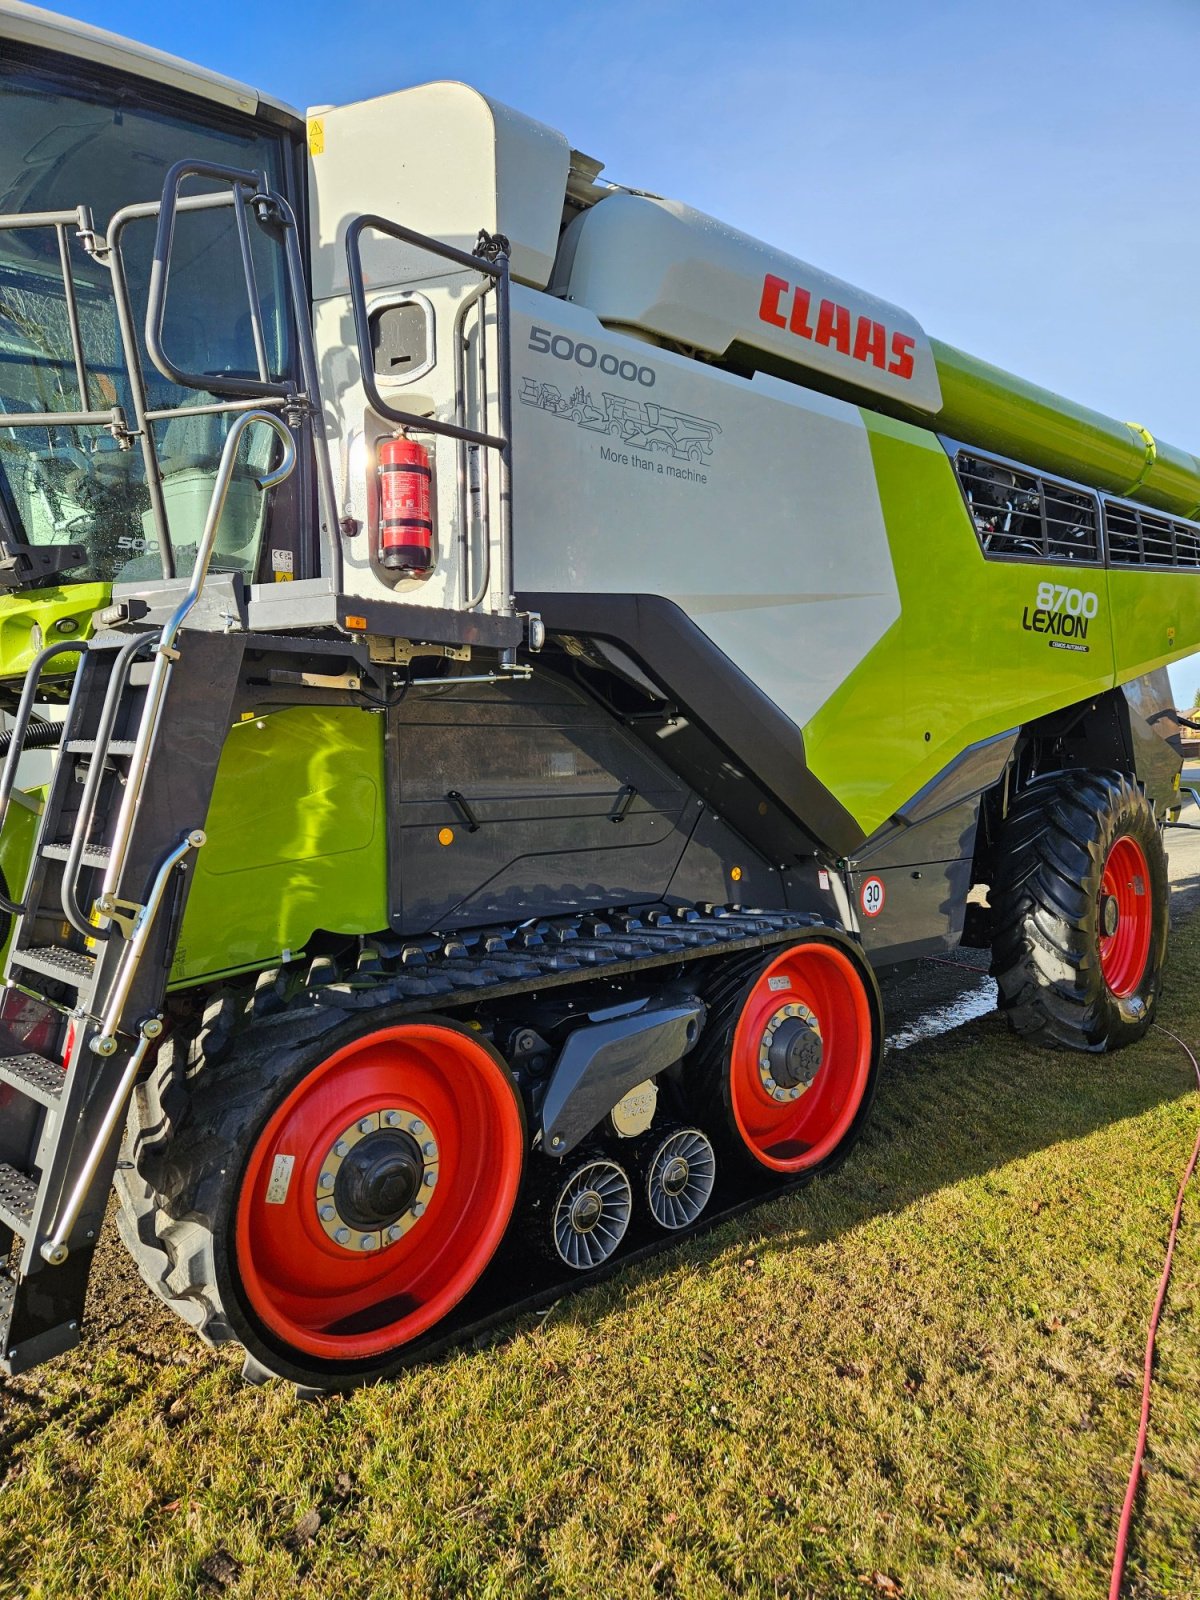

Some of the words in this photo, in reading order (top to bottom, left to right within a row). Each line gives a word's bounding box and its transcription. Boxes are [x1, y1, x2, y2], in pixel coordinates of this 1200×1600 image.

[758, 273, 915, 380] CLAAS
[600, 446, 629, 466] More
[631, 454, 654, 472] than
[657, 464, 664, 474] a
[666, 466, 707, 484] machine
[1036, 582, 1099, 619] 8700
[1022, 607, 1089, 639] LEXION
[866, 884, 880, 903] 30
